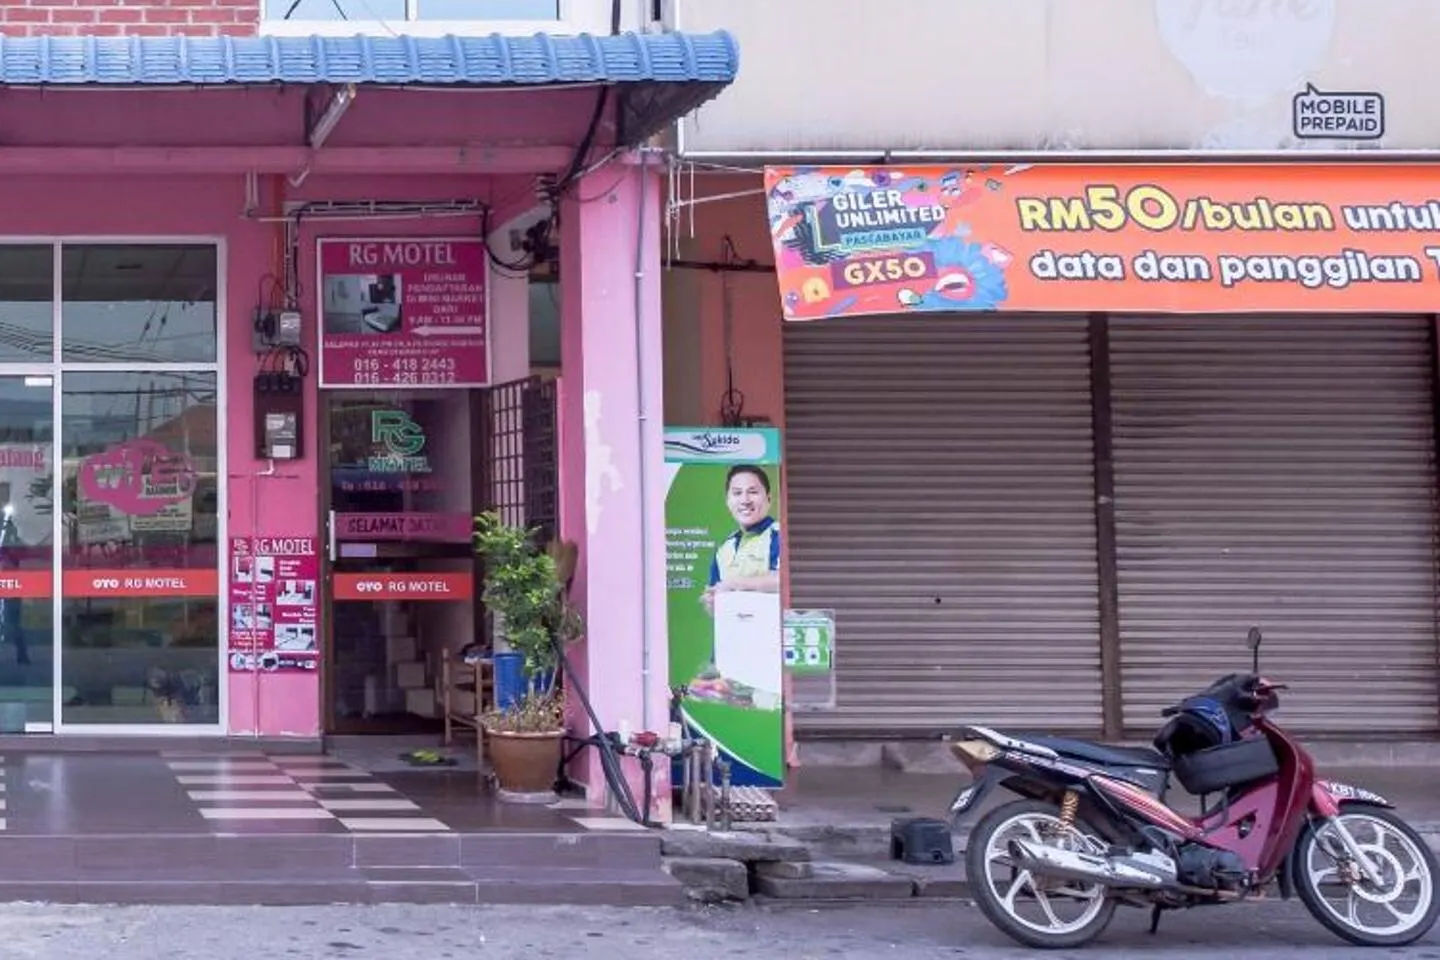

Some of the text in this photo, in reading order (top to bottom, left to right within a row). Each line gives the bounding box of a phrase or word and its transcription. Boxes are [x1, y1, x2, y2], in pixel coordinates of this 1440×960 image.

[1300, 99, 1376, 115] MOBILE
[1300, 116, 1378, 132] PREPAID
[833, 190, 903, 211] GILER
[835, 204, 946, 228] UNLIMITED
[349, 243, 456, 265] RG MOTEL
[843, 256, 927, 286] GX50
[1030, 250, 1124, 281] data
[1132, 250, 1211, 281] dan
[1217, 248, 1422, 288] panggilan
[347, 518, 405, 533] SELAMAT
[271, 539, 313, 553] MOTEL
[145, 578, 187, 589] MOTEL
[409, 581, 450, 592] MOTEL
